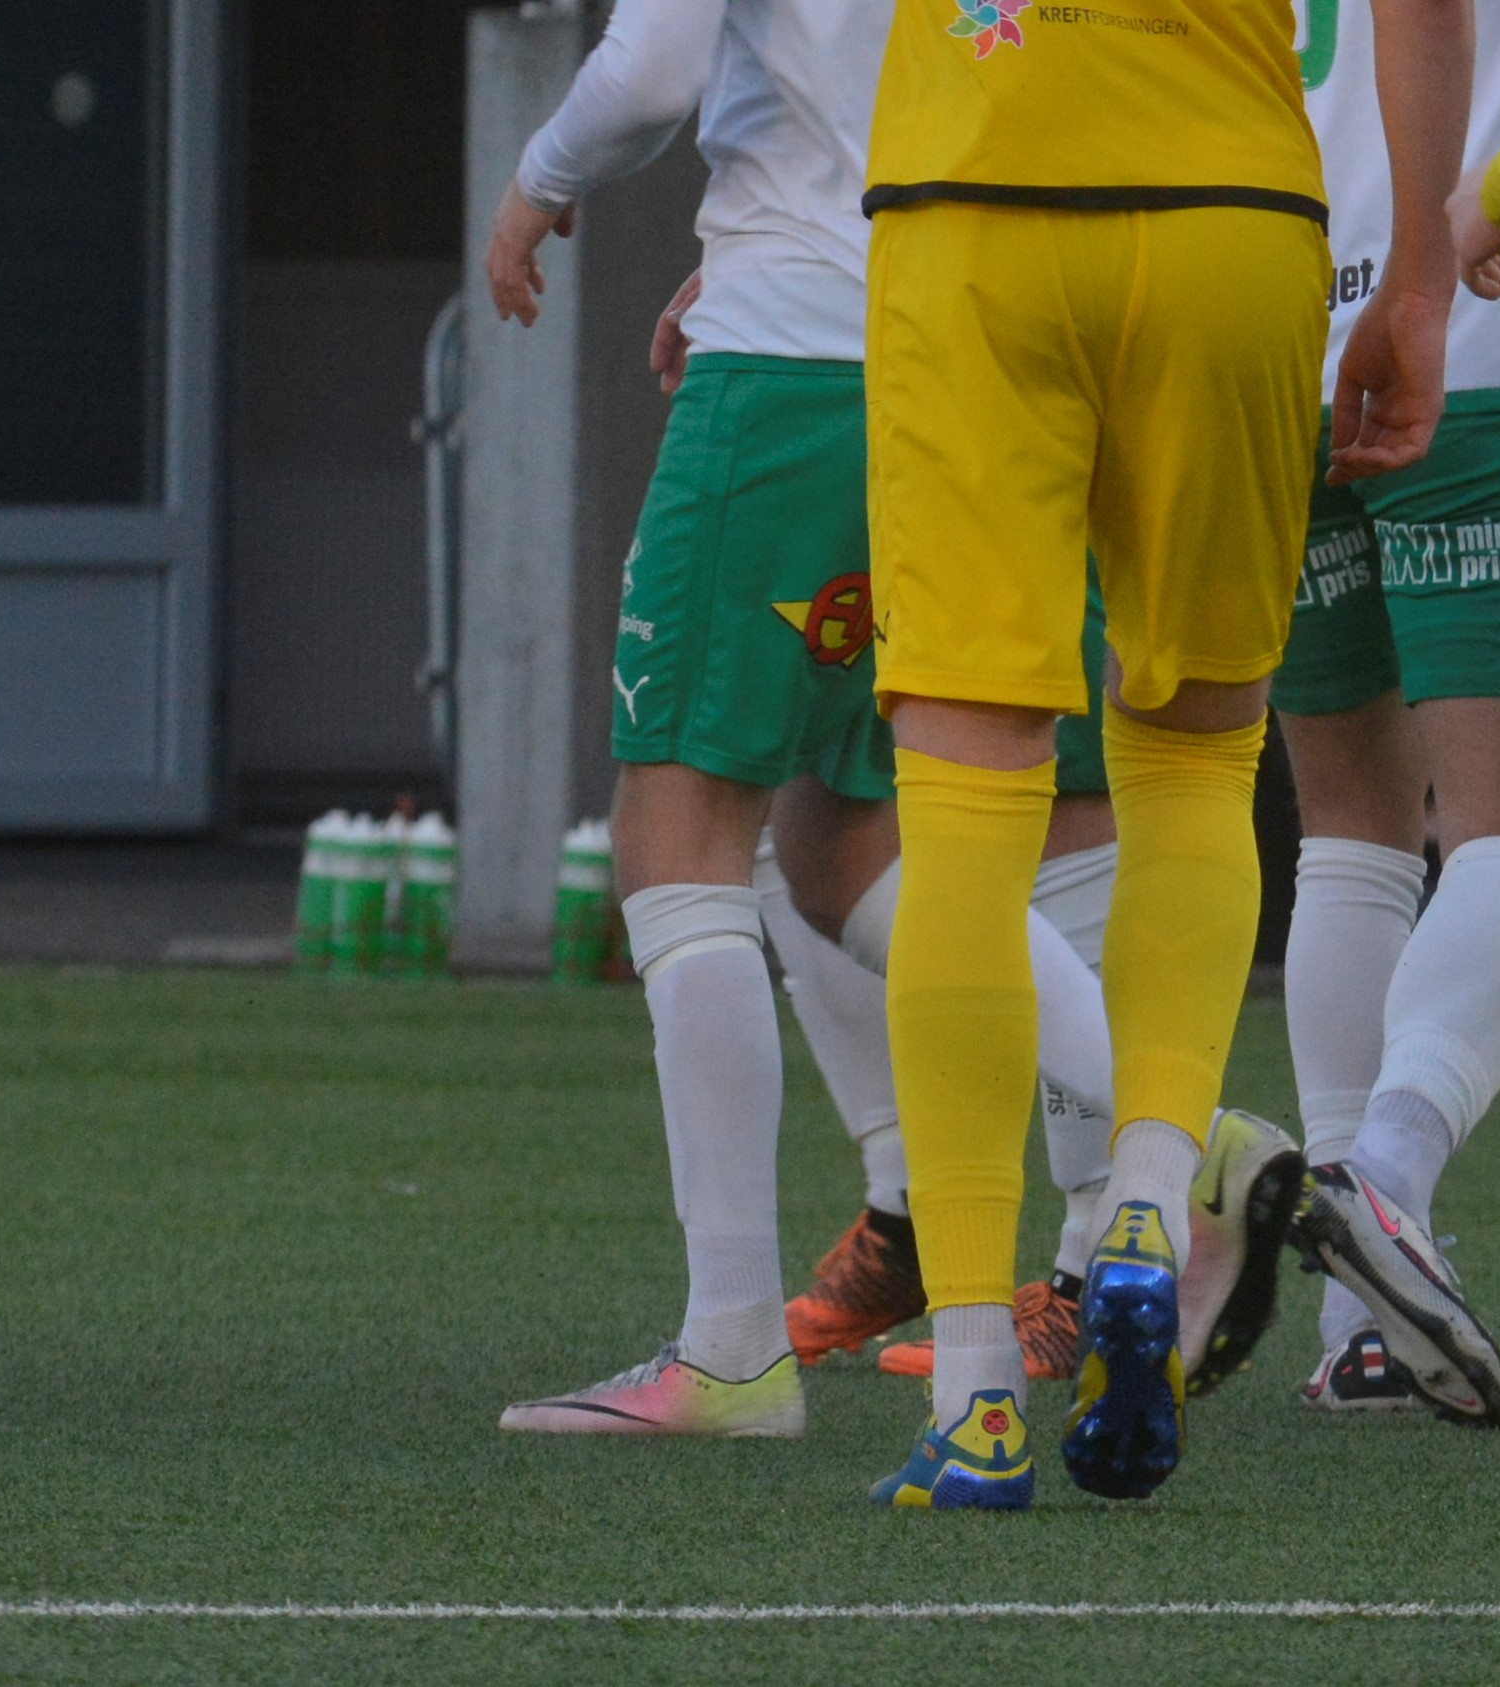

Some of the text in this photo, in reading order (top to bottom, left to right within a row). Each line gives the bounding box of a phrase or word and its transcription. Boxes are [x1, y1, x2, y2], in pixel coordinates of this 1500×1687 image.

[1038, 5, 1190, 37] KREFTFORENINGEN
[1308, 523, 1371, 571] mini
[1317, 559, 1371, 608] pris
